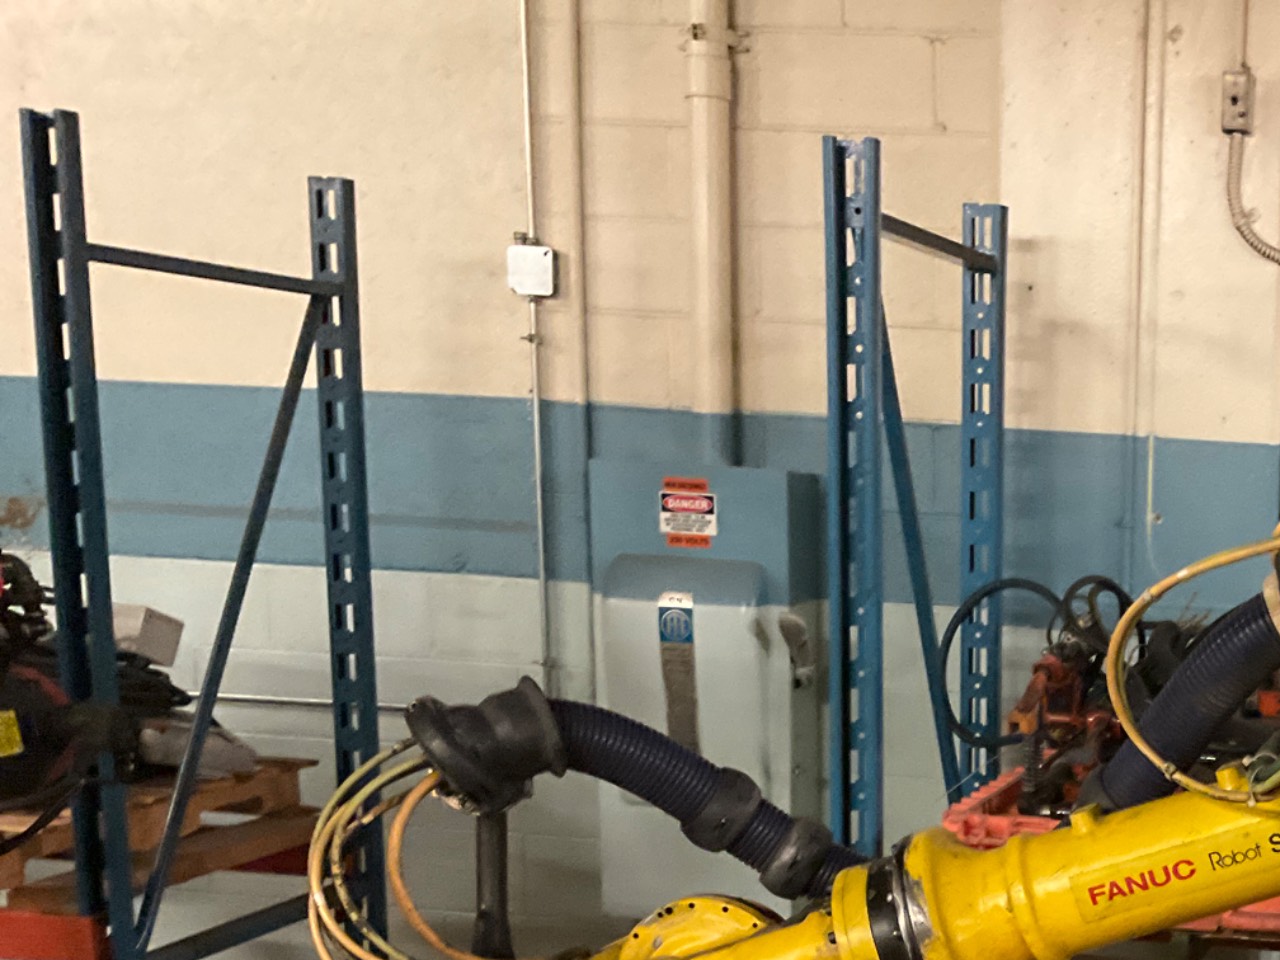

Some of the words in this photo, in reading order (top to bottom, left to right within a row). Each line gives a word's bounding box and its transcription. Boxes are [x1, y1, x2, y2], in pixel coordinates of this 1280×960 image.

[667, 498, 708, 510] DANGER
[1088, 859, 1196, 906] FANUC
[1208, 842, 1262, 871] Robot
